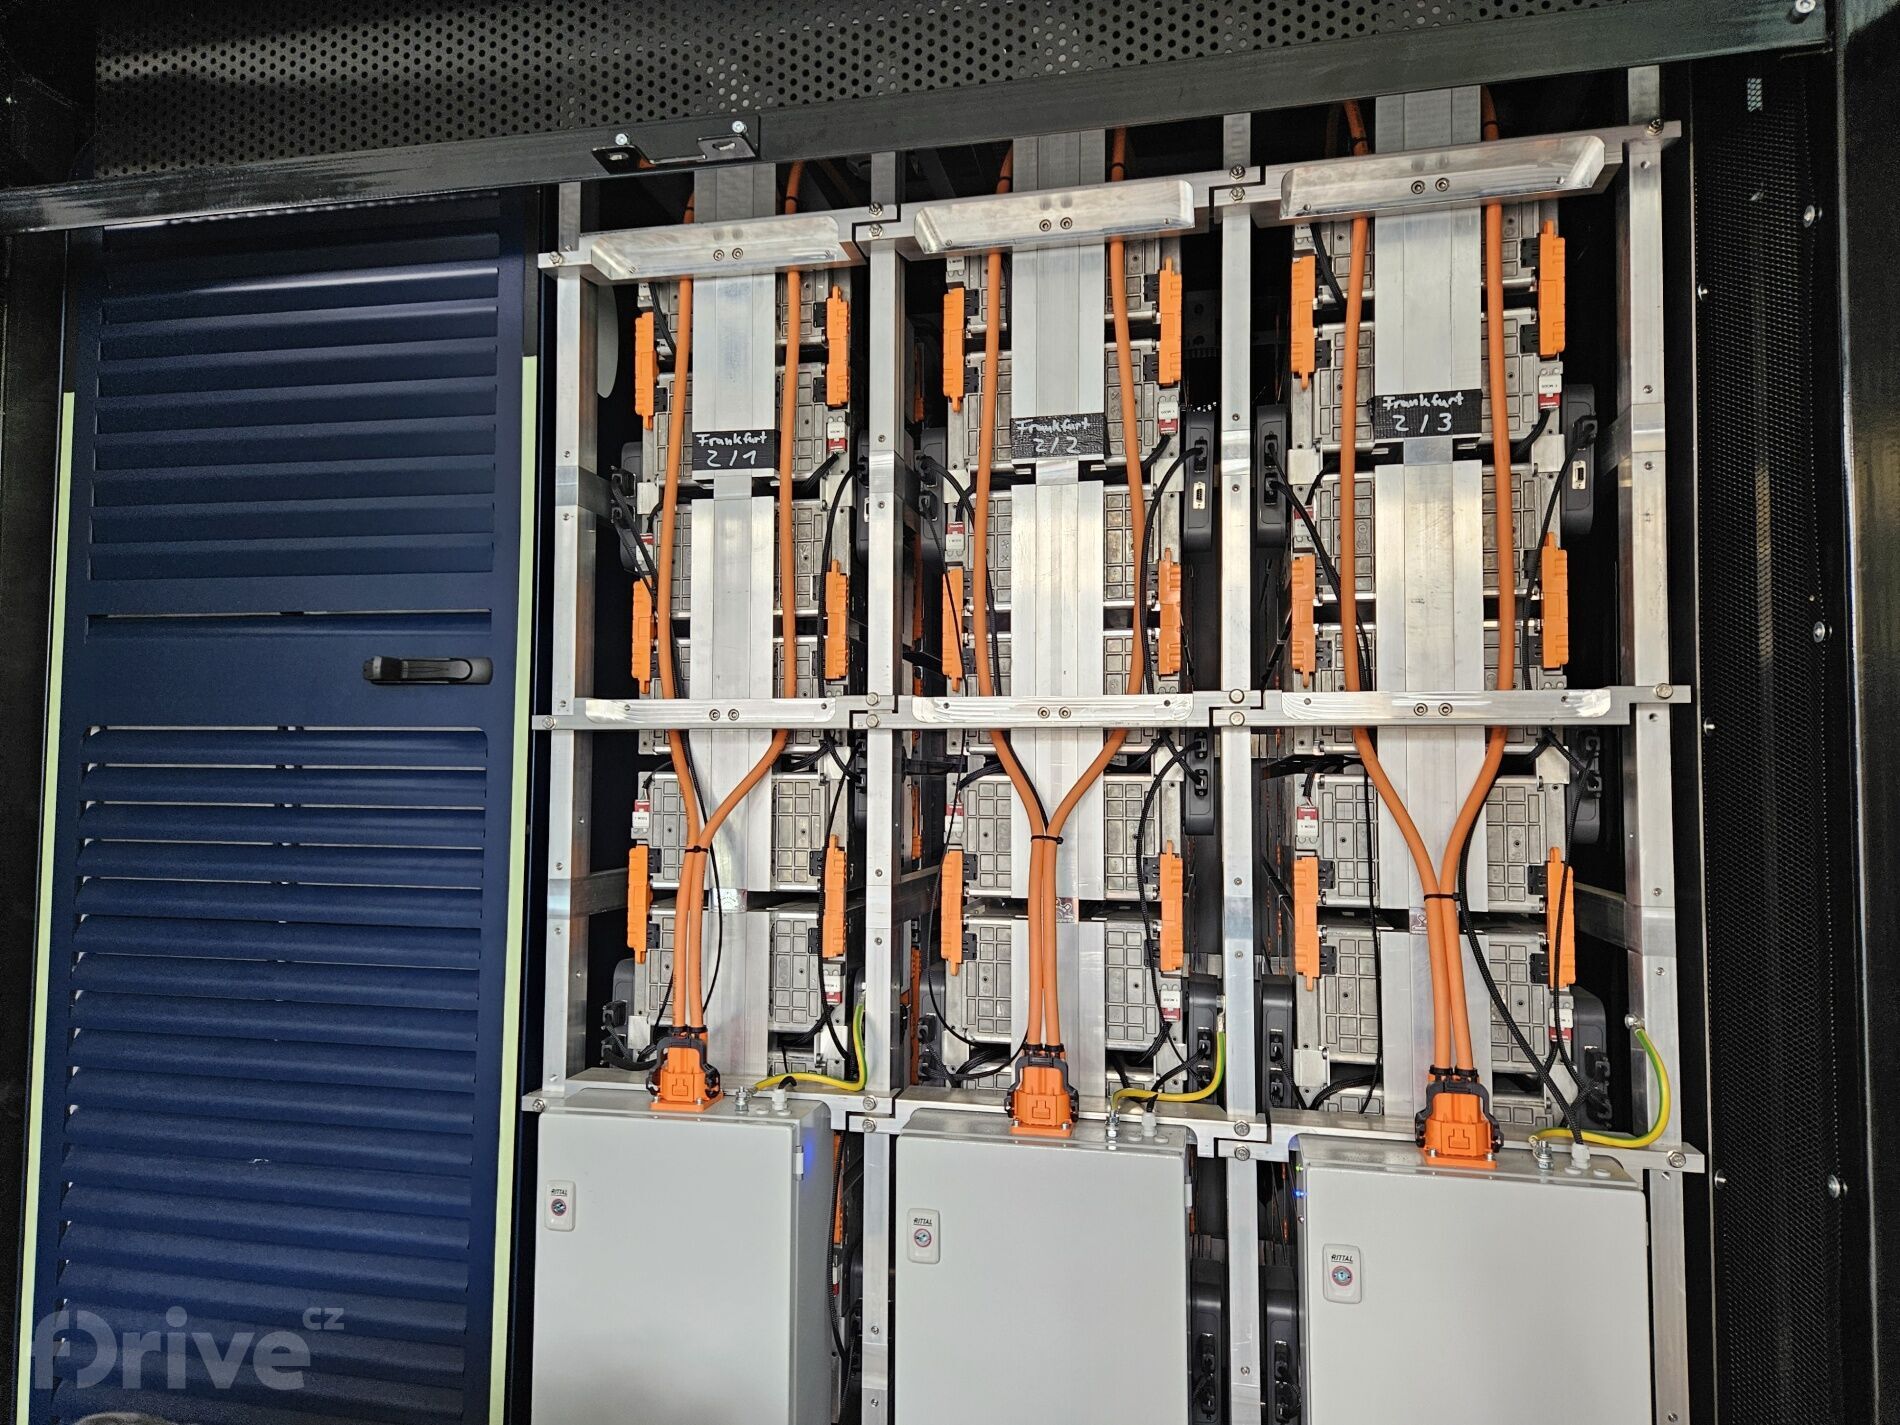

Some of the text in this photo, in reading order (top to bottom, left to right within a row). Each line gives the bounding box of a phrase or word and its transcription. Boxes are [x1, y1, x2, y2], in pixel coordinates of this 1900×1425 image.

[1382, 391, 1464, 411] Frankfurt
[1014, 416, 1091, 435] Frankfurt
[695, 430, 768, 447] Frankfurt
[913, 1217, 932, 1226] RITTAL
[1331, 1253, 1353, 1263] RITTAL
